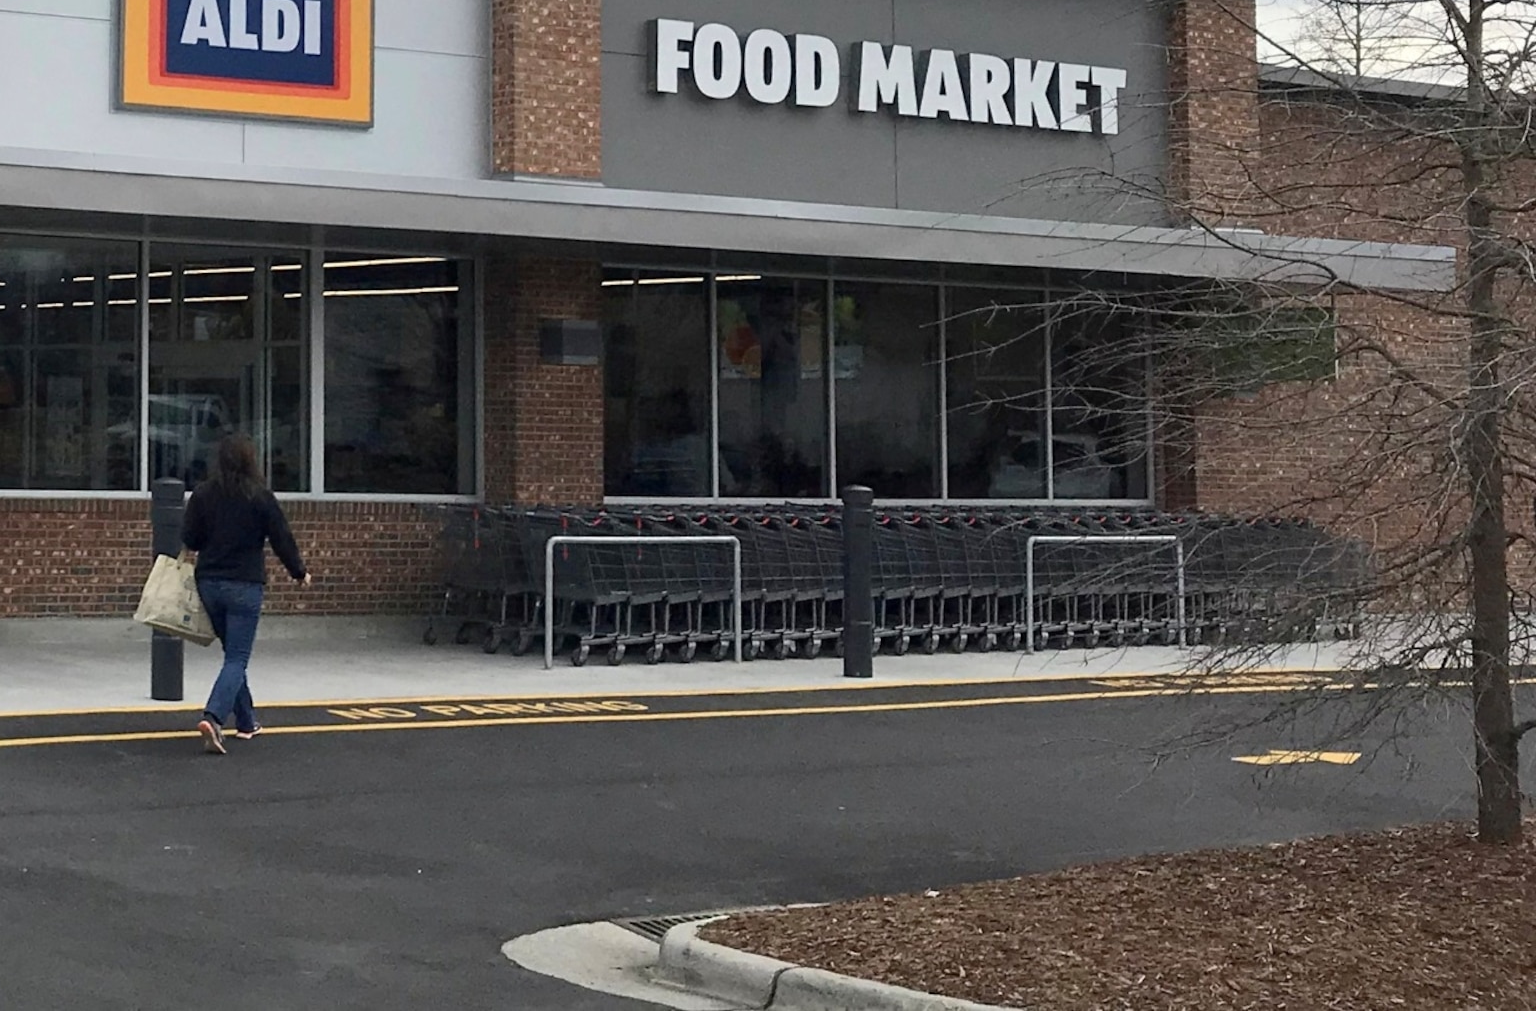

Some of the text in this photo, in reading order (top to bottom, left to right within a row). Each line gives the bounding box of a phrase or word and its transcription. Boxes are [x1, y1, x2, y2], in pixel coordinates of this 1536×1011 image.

[656, 17, 1128, 135] FOOD MARKET
[326, 700, 649, 720] NO PARKING
